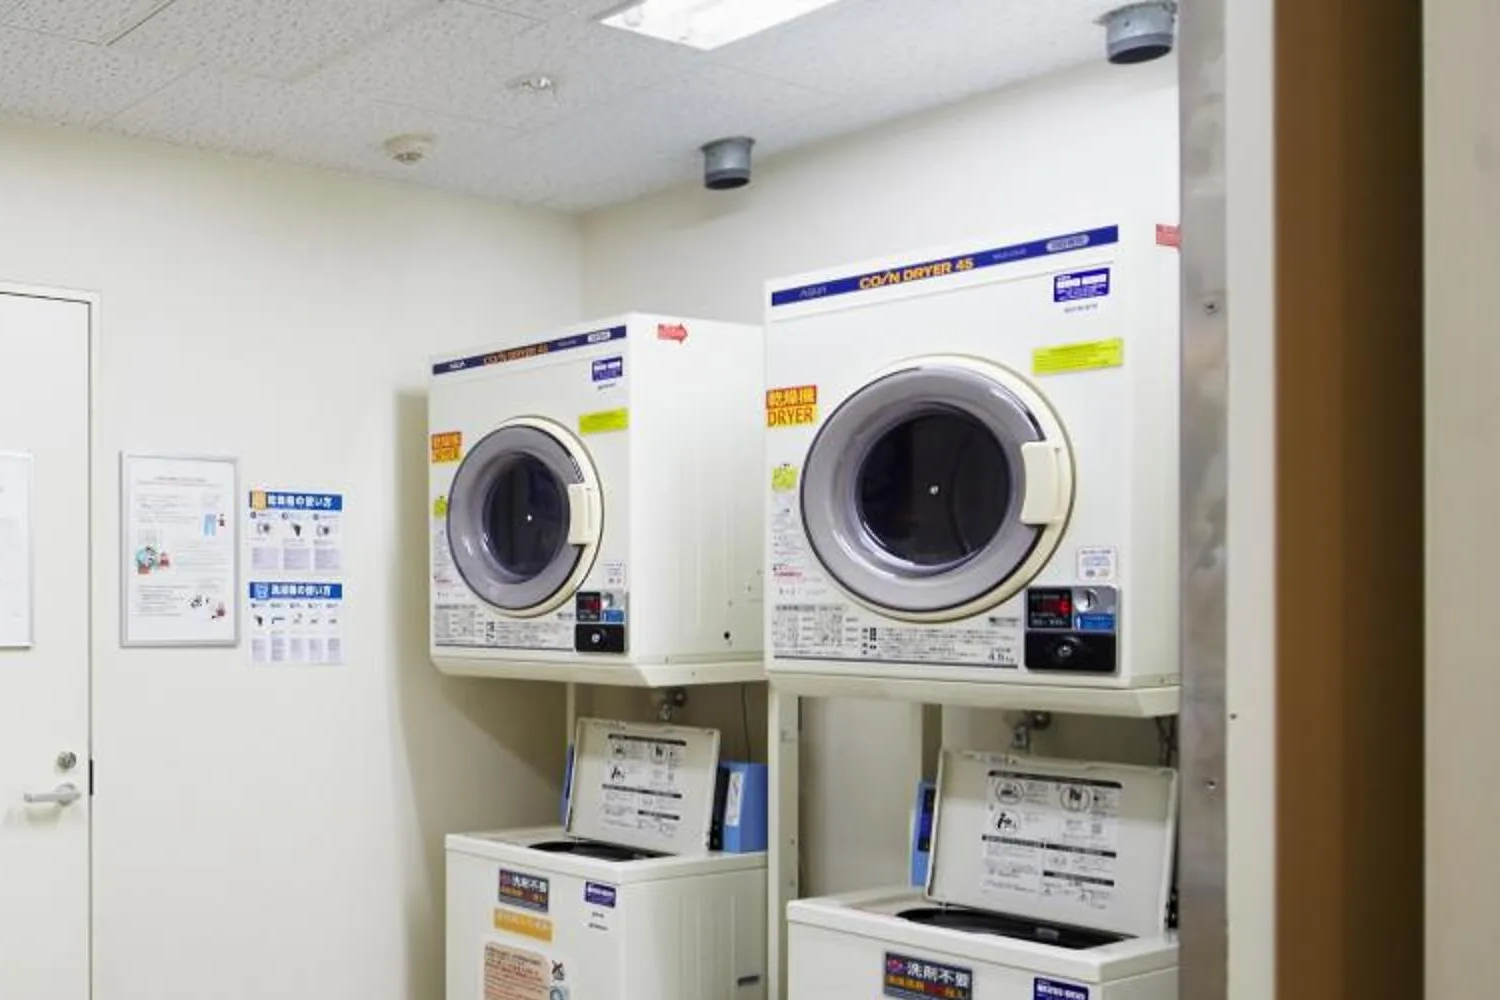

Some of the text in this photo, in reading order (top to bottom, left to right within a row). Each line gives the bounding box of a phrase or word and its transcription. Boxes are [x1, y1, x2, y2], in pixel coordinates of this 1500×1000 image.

[903, 262, 953, 281] DRYER
[956, 257, 975, 271] 45
[767, 408, 813, 426] DRYER
[907, 960, 970, 988] 洗剤不要
